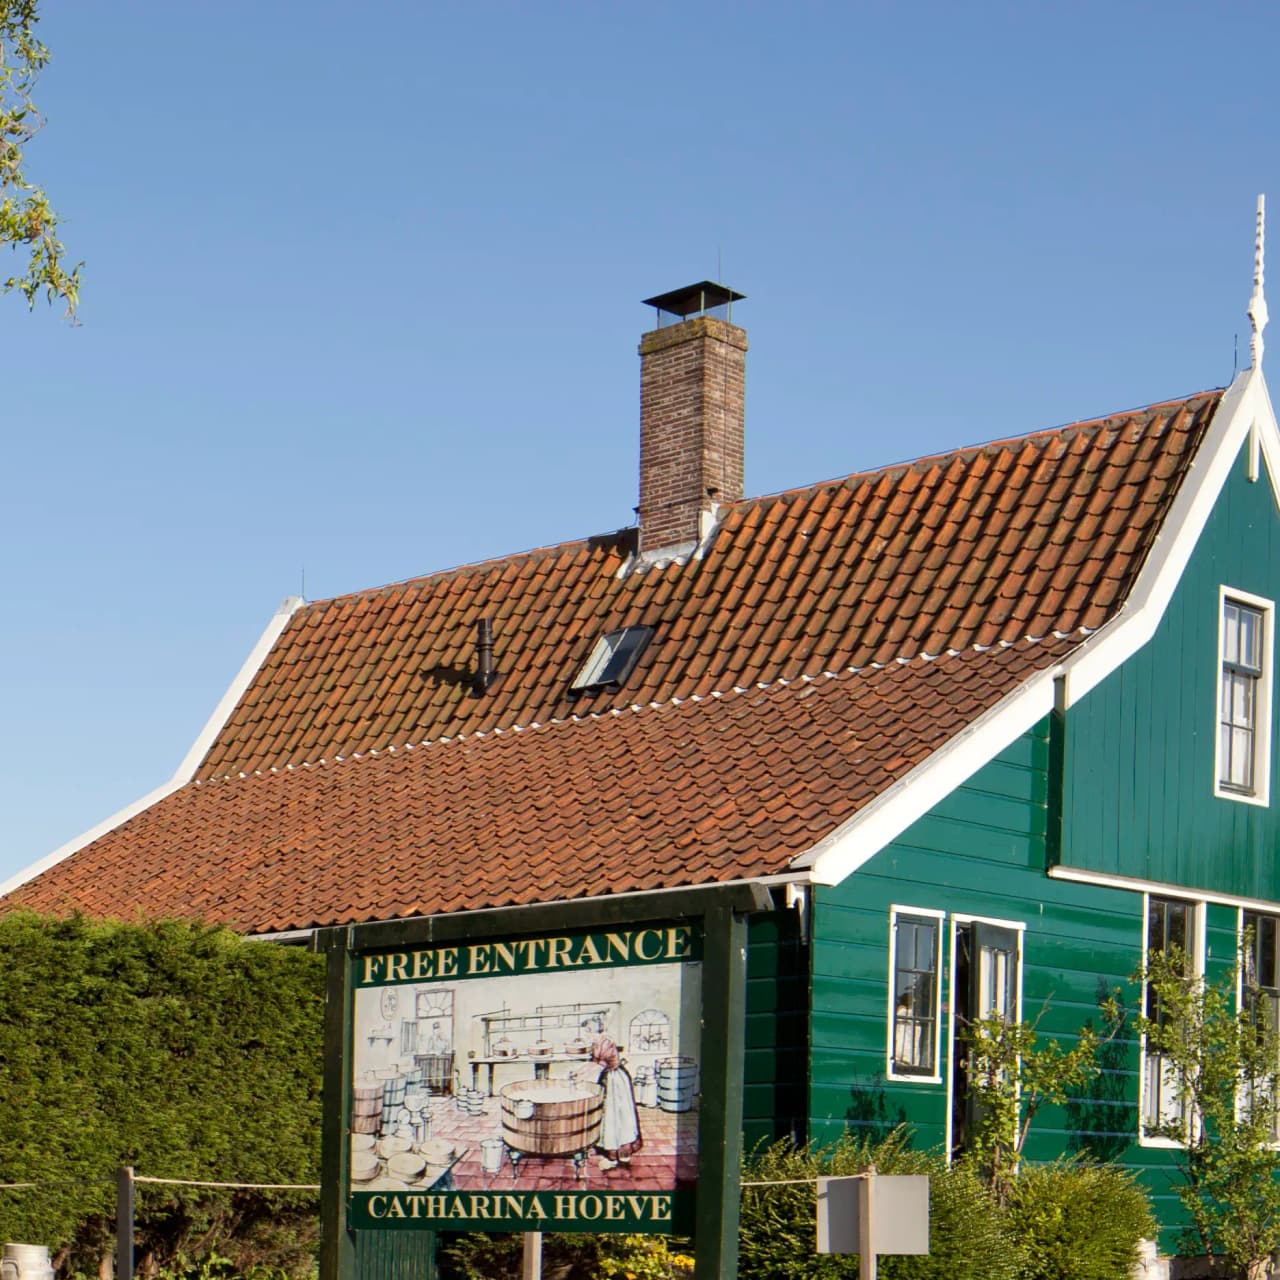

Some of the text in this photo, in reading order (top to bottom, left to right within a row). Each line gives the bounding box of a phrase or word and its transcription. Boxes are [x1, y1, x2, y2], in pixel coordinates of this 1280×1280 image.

[361, 926, 693, 984] FREE ENTRANCE
[368, 1195, 672, 1221] CATHARINA HOEVE
